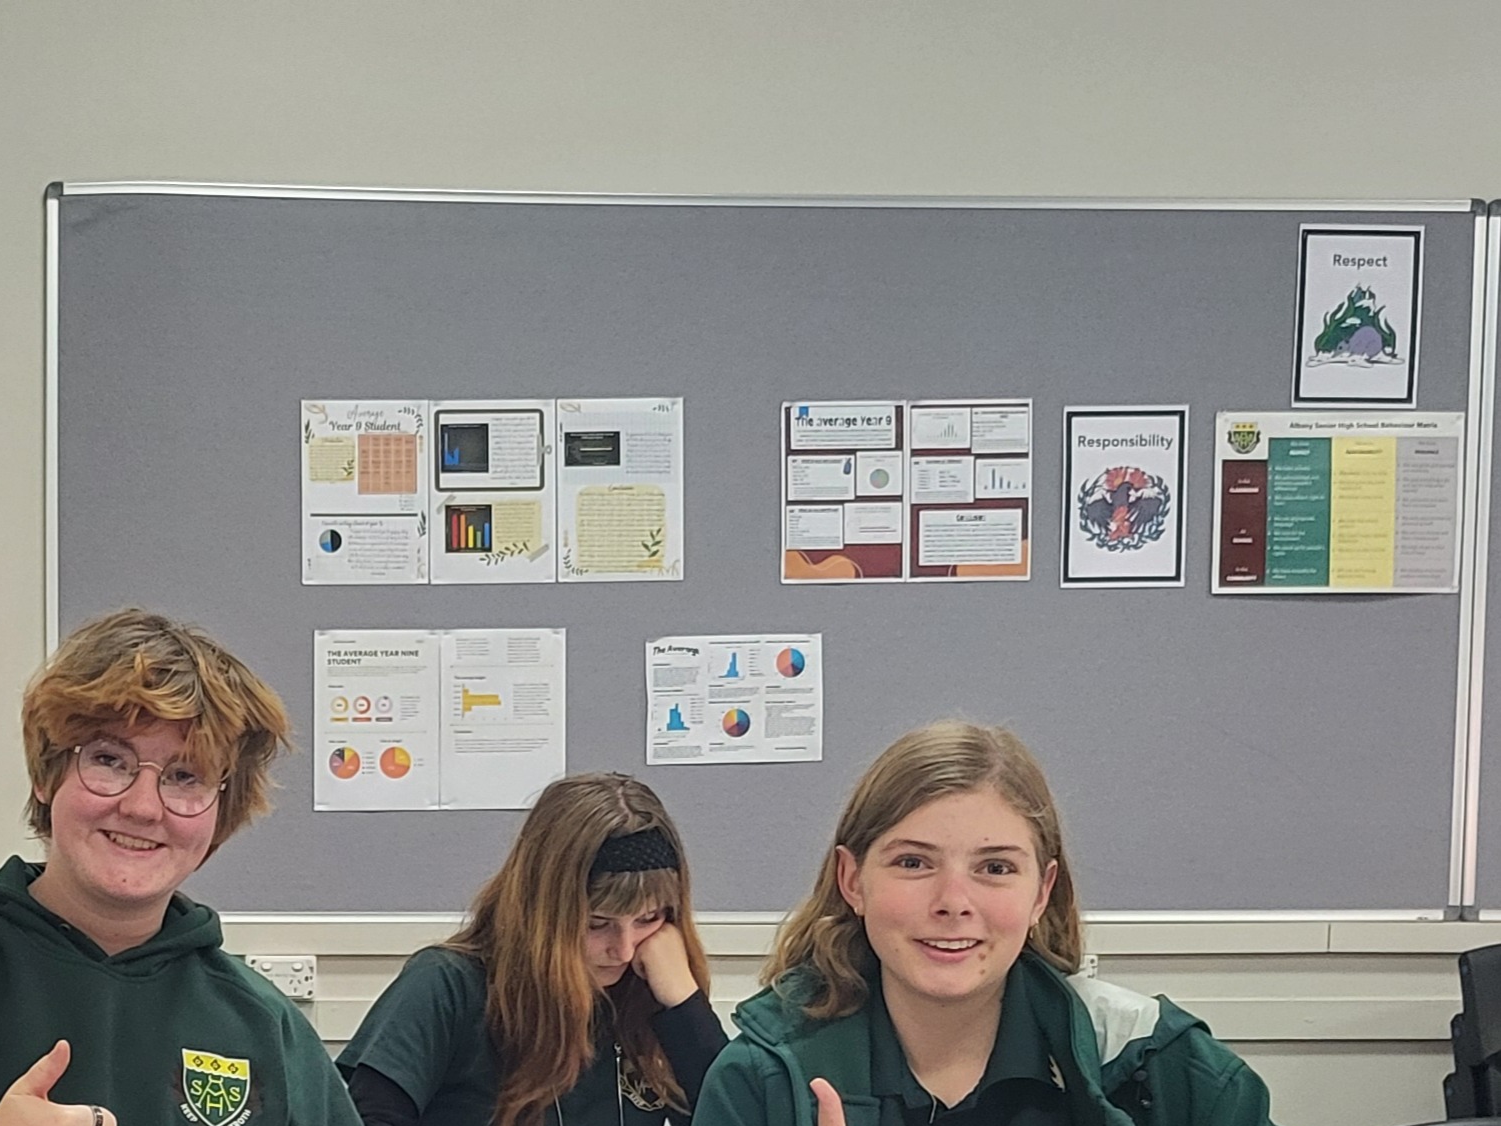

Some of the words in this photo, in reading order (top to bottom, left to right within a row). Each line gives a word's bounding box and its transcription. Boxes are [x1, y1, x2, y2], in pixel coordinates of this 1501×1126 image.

[1332, 253, 1388, 270] Respect
[346, 404, 384, 420] Average
[328, 421, 353, 431] Year
[355, 421, 363, 431] 9
[364, 420, 401, 432] Student
[795, 416, 814, 427] The
[816, 416, 858, 428] average
[885, 415, 892, 425] 9
[1338, 422, 1355, 430] High
[1077, 434, 1174, 452] Responsibility
[379, 649, 400, 657] YEAR
[401, 649, 419, 657] NINE
[652, 646, 666, 656] The
[180, 1103, 199, 1122] KEEP
